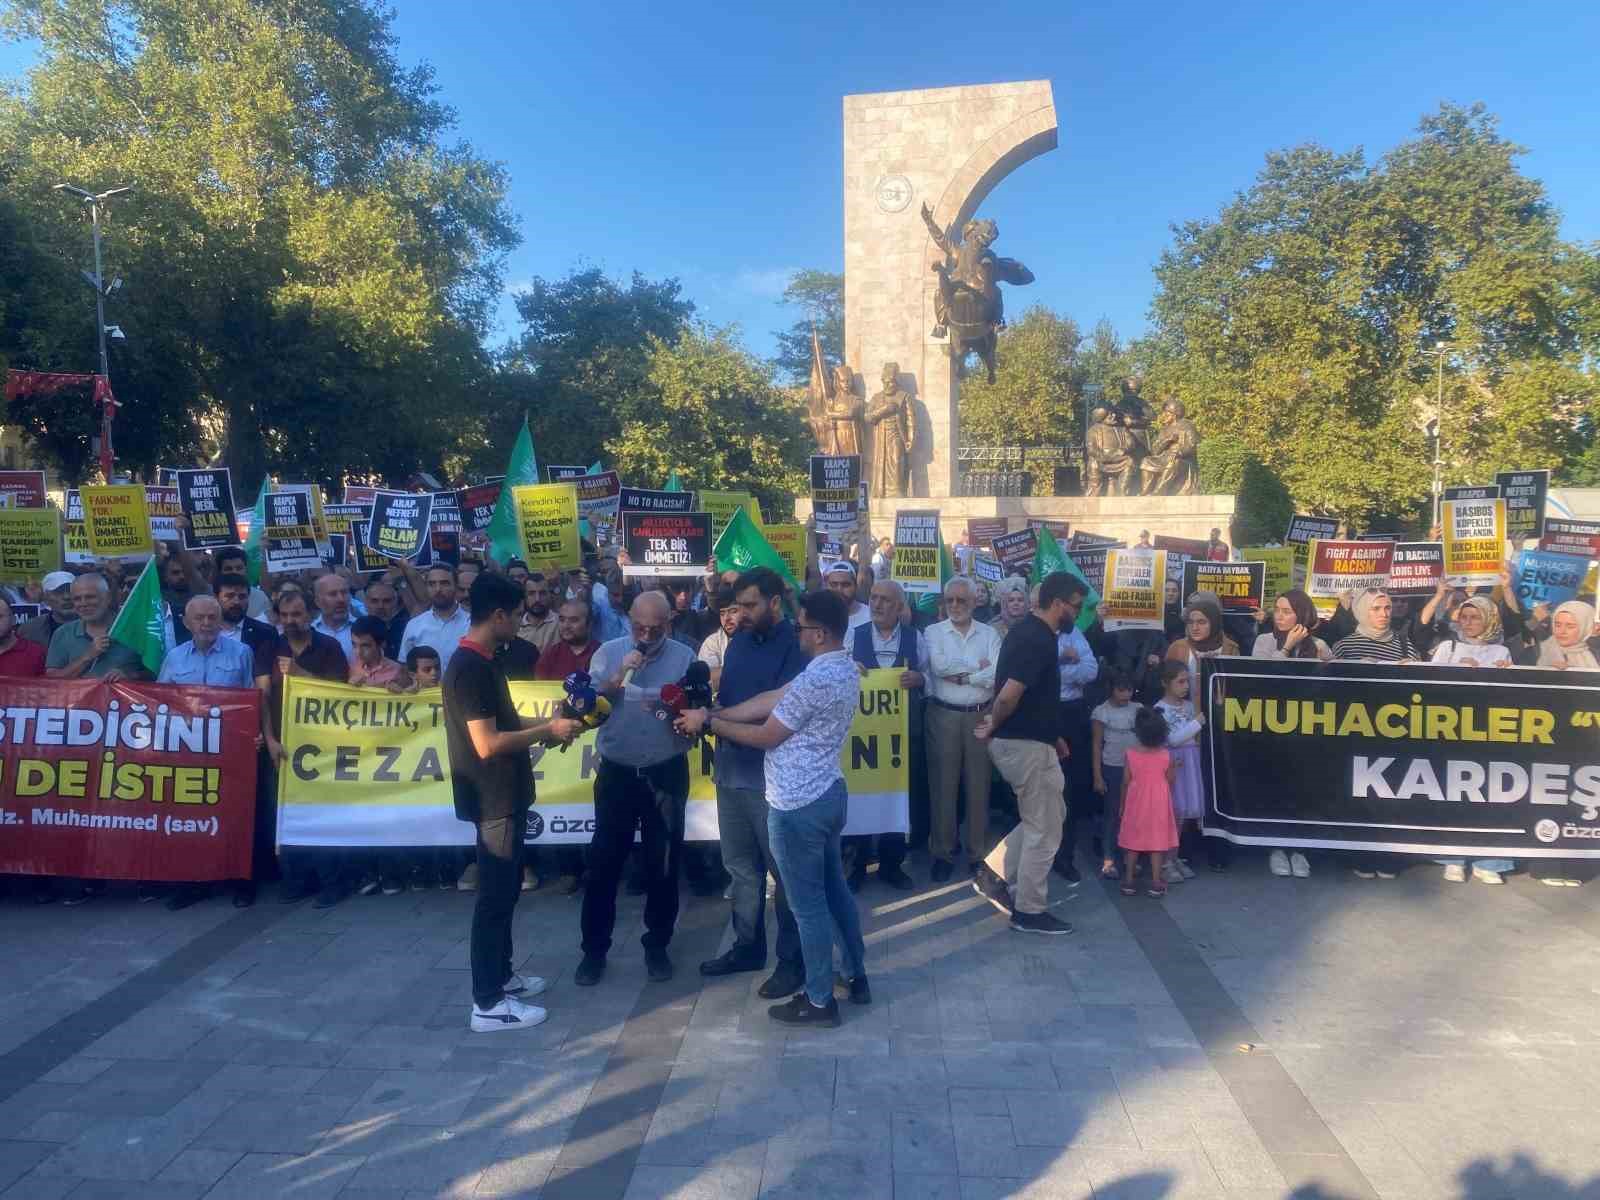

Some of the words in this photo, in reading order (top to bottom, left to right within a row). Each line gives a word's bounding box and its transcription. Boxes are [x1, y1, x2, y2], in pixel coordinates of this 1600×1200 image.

[648, 538, 668, 550] TEK
[670, 537, 687, 550] BİR
[1325, 548, 1349, 559] FIGHT
[1351, 548, 1387, 560] AGAINST
[644, 550, 692, 564] ÜMMETİZ!
[1334, 560, 1376, 573] RACISM
[294, 696, 418, 732] IRKÇILIK,
[1223, 693, 1556, 745] MUHACİRLER
[16, 759, 89, 797] DE
[99, 751, 220, 805] İSTE!
[31, 808, 158, 831] Muhammed
[164, 816, 219, 836] (sav)
